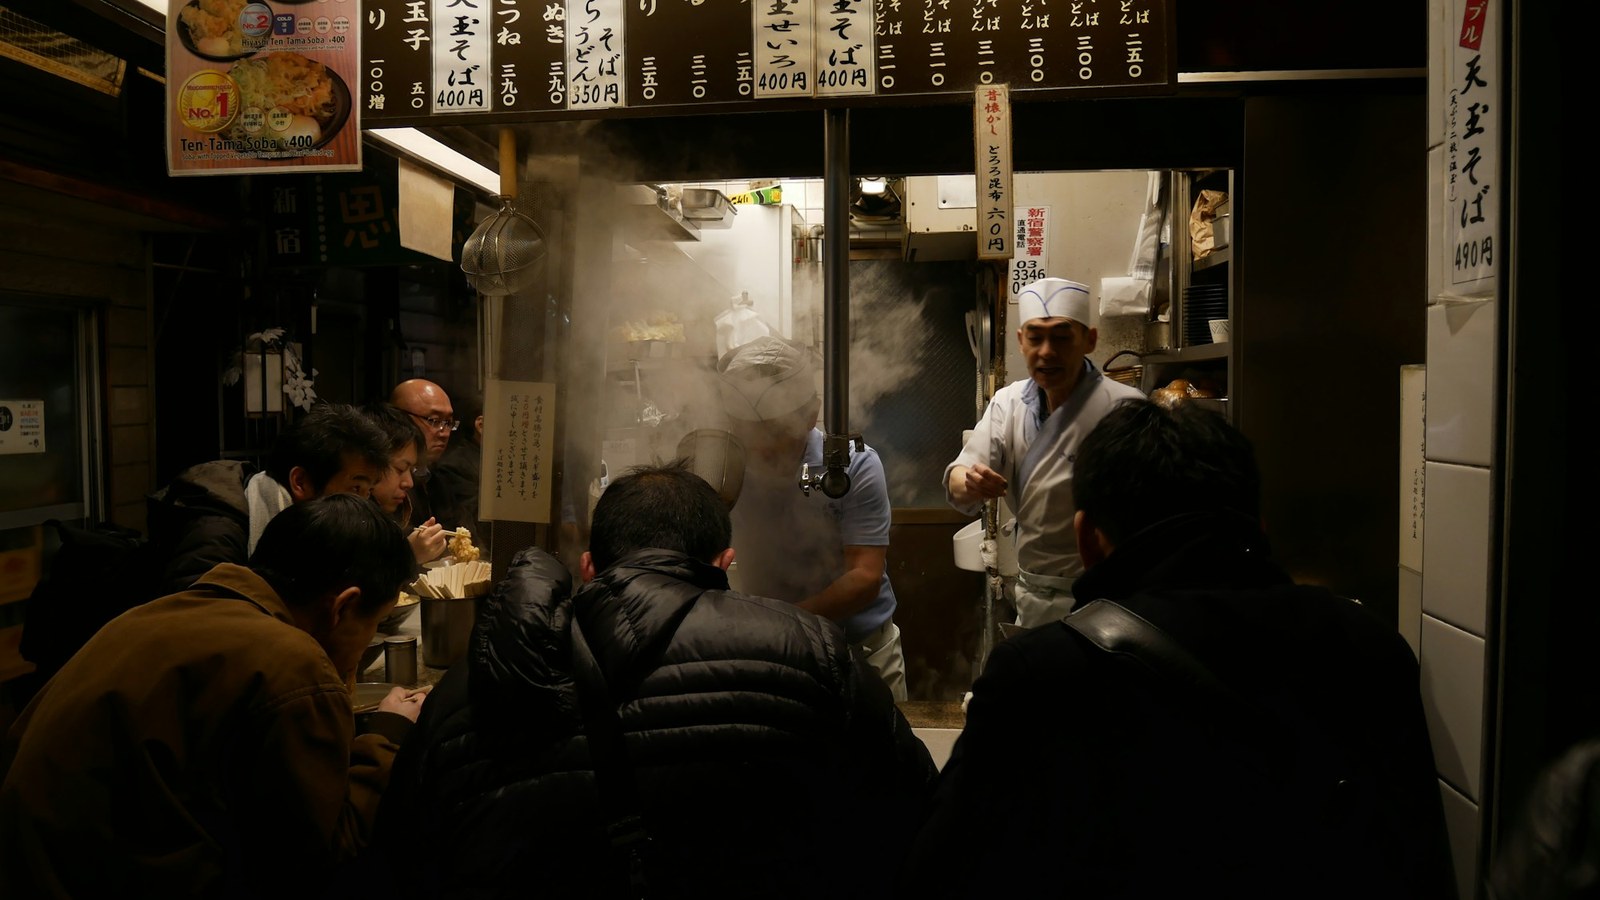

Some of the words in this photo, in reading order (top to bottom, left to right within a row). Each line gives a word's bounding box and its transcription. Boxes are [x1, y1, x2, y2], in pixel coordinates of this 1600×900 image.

[368, 8, 386, 30] り
[402, 1, 430, 51] 玉子
[497, 0, 521, 45] つね
[542, 3, 567, 44] ぬき
[1020, 0, 1034, 29] どん
[1070, 0, 1084, 27] どん
[1086, 0, 1100, 26] ば
[307, 36, 325, 44] Soba
[572, 26, 597, 82] うどん
[599, 27, 620, 76] そば
[1028, 38, 1045, 82] 三〇〇
[1076, 36, 1093, 80] 三〇〇
[1125, 33, 1144, 78] 二五〇
[548, 61, 566, 104] 三九〇
[641, 56, 658, 99] 三五〇
[758, 71, 807, 90] 400円
[818, 68, 866, 87] 400円
[879, 44, 896, 88] 三一〇
[929, 42, 946, 86] 三一〇
[978, 40, 995, 84] 三一〇
[410, 81, 425, 109] 五〇
[437, 88, 483, 107] 400円
[501, 63, 518, 106] 三九〇
[571, 83, 619, 104] 350円
[984, 90, 1001, 135] 昔懐かし
[180, 137, 243, 152] Ten-Tama
[246, 136, 277, 150] Soba
[1460, 54, 1491, 228] 天玉そば
[1016, 220, 1026, 248] 直通電話
[1027, 207, 1045, 256] 新宿警察署
[1016, 260, 1037, 269] 03
[1455, 236, 1493, 270] 490円
[1012, 268, 1045, 281] 3346
